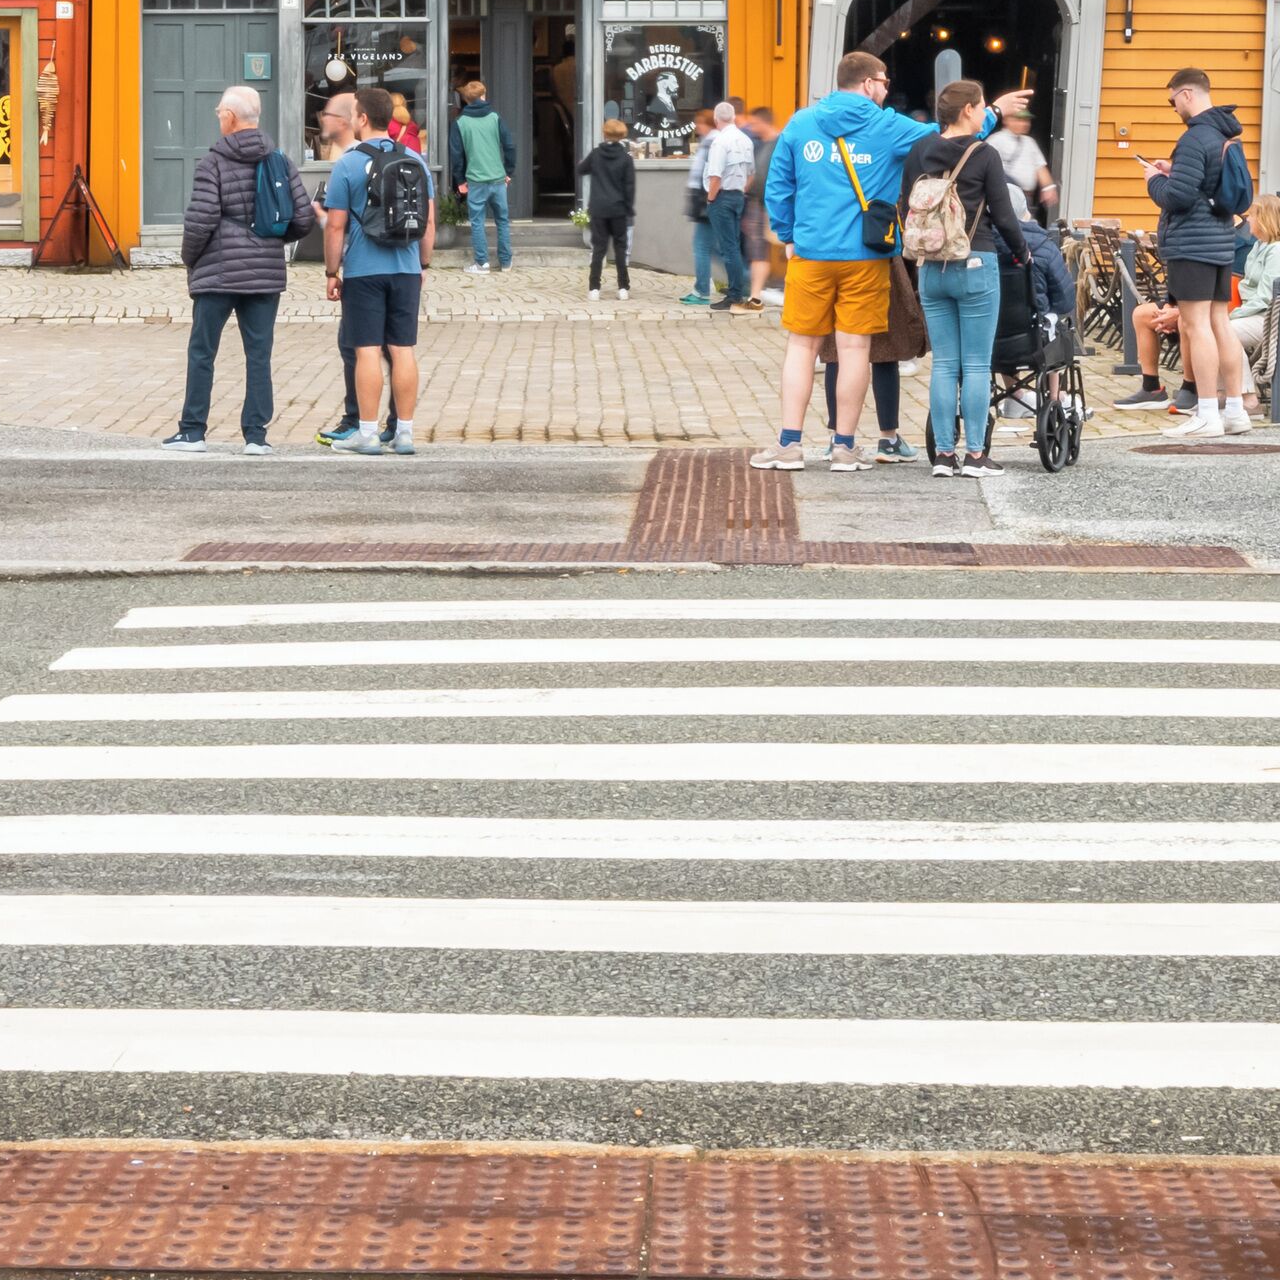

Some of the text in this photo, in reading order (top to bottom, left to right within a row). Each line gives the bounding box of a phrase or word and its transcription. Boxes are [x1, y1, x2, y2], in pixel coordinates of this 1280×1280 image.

[649, 44, 681, 54] BERGEN
[351, 53, 404, 61] VIGELAND
[625, 54, 704, 81] BARBERSTUE
[633, 121, 697, 139] AVD. BRYGGEN
[830, 153, 872, 165] FIDER
